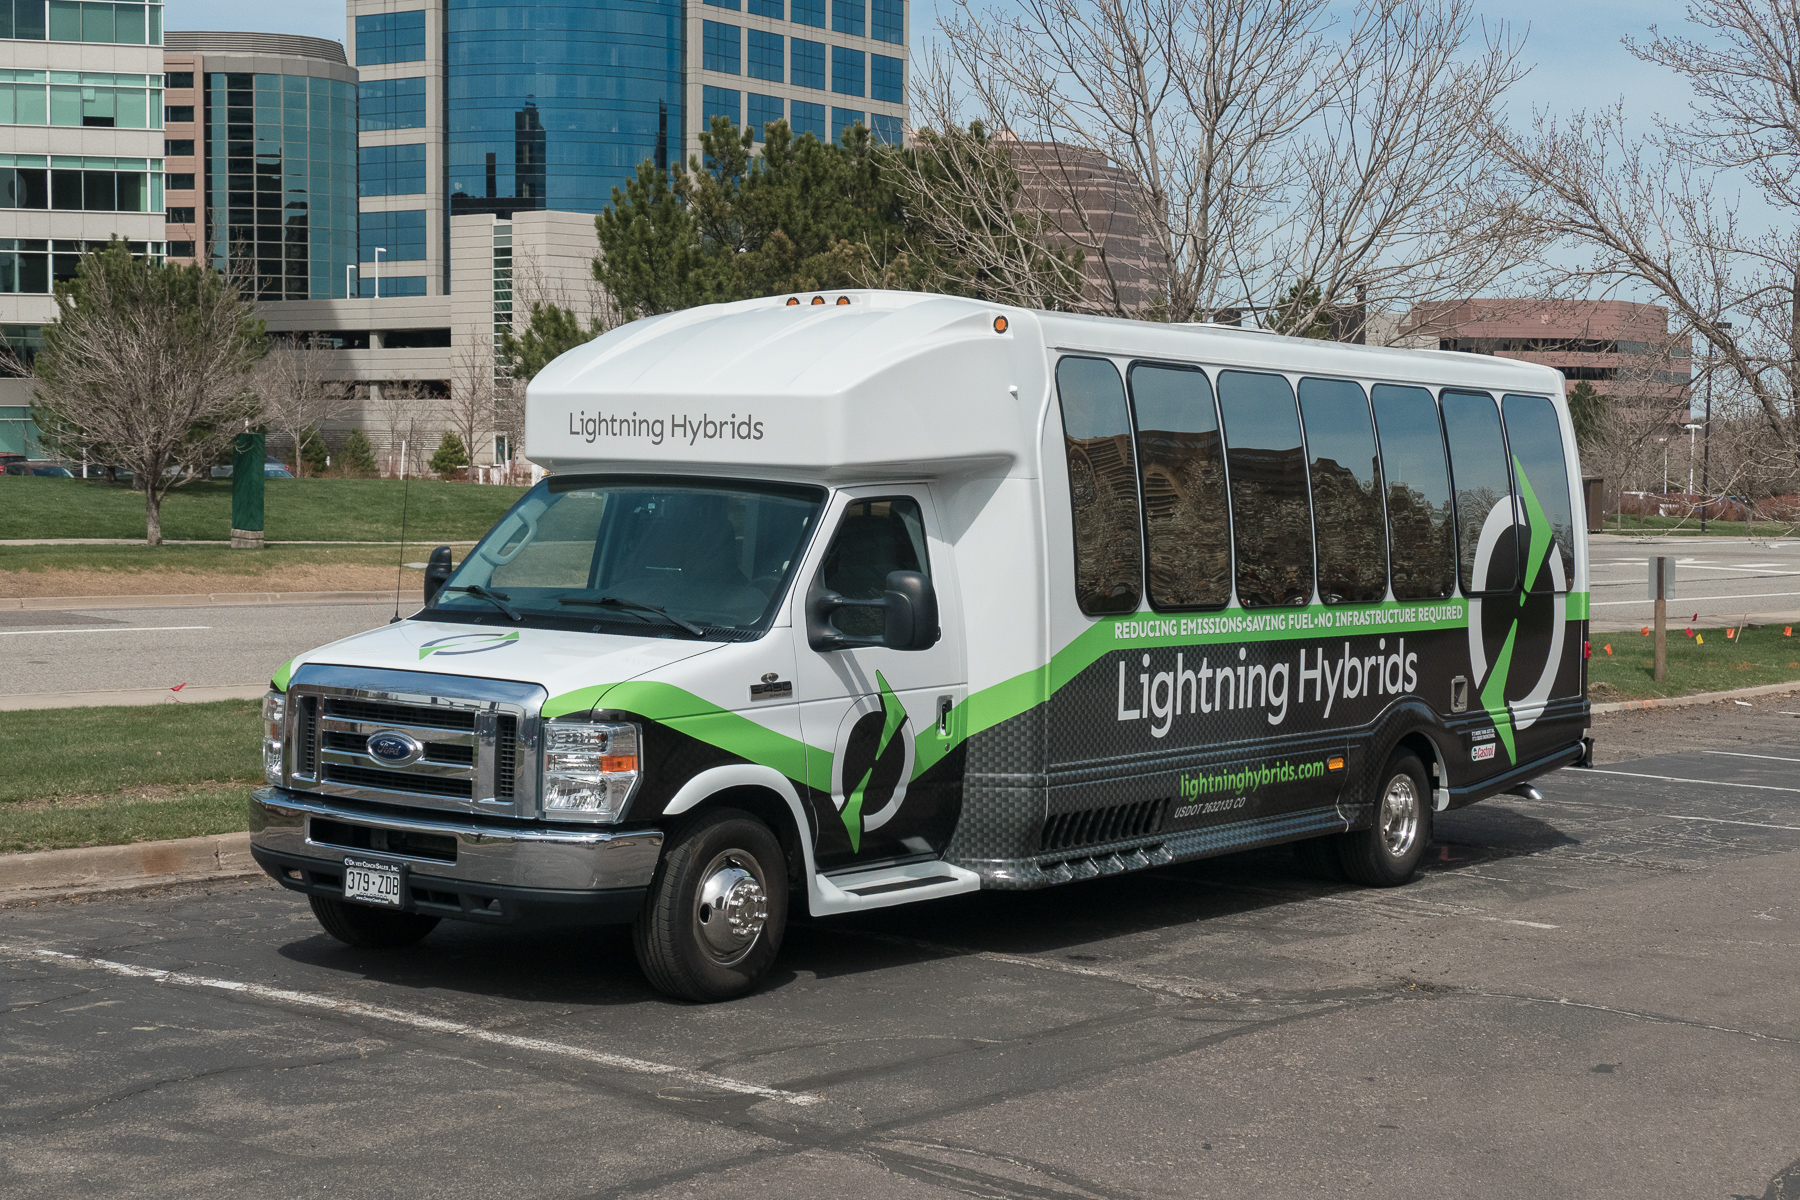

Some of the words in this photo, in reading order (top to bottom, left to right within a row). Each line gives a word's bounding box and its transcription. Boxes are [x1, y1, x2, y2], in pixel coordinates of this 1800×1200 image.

[569, 411, 664, 446] Lightning
[671, 413, 764, 446] Hybrids
[1115, 620, 1177, 639] REDUCING
[1335, 608, 1416, 627] INFRASTRUCTURE
[1418, 605, 1463, 623] REQUIRED
[1117, 647, 1290, 738] Lightning
[1298, 637, 1418, 719] Hybrids
[377, 740, 402, 756] Ford
[1477, 745, 1494, 759] Castrol
[1180, 761, 1325, 802] lightninghybrids.com
[1174, 803, 1204, 818] USDOT
[1233, 797, 1246, 809] CO
